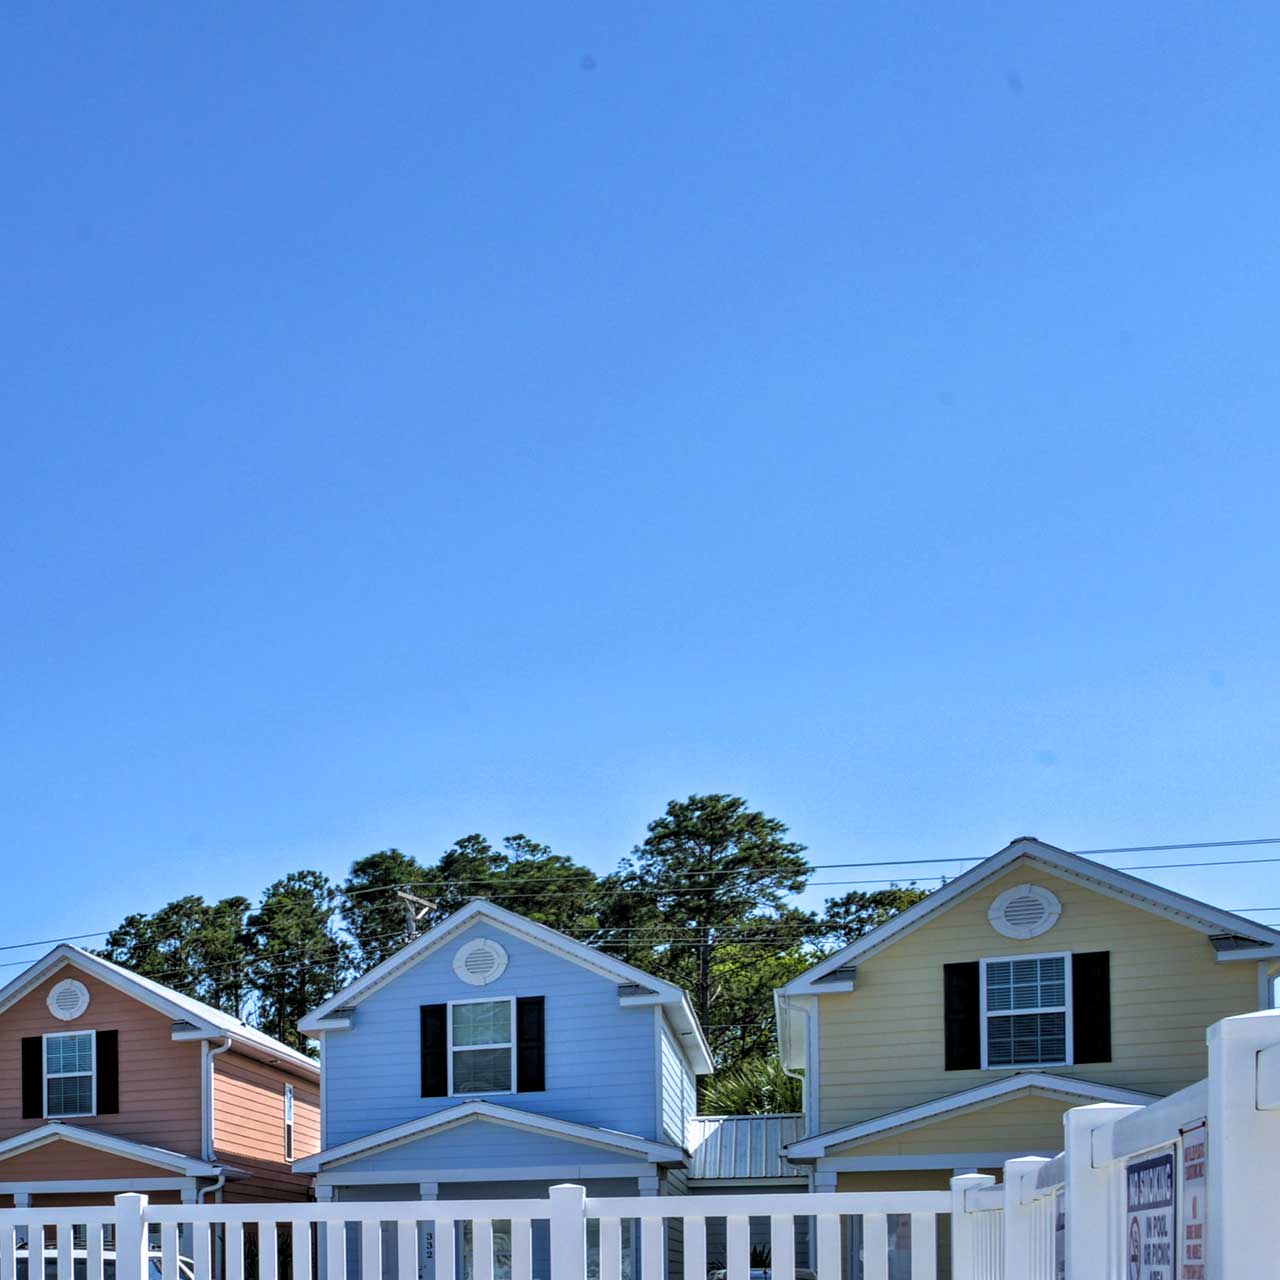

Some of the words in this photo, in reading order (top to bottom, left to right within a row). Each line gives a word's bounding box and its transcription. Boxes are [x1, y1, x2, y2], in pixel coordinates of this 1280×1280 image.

[1129, 1172, 1138, 1205] NO
[1140, 1164, 1171, 1203] SMOKING
[1146, 1217, 1152, 1238] IN
[1154, 1215, 1168, 1237] POOL
[1152, 1243, 1171, 1266] PICNIC
